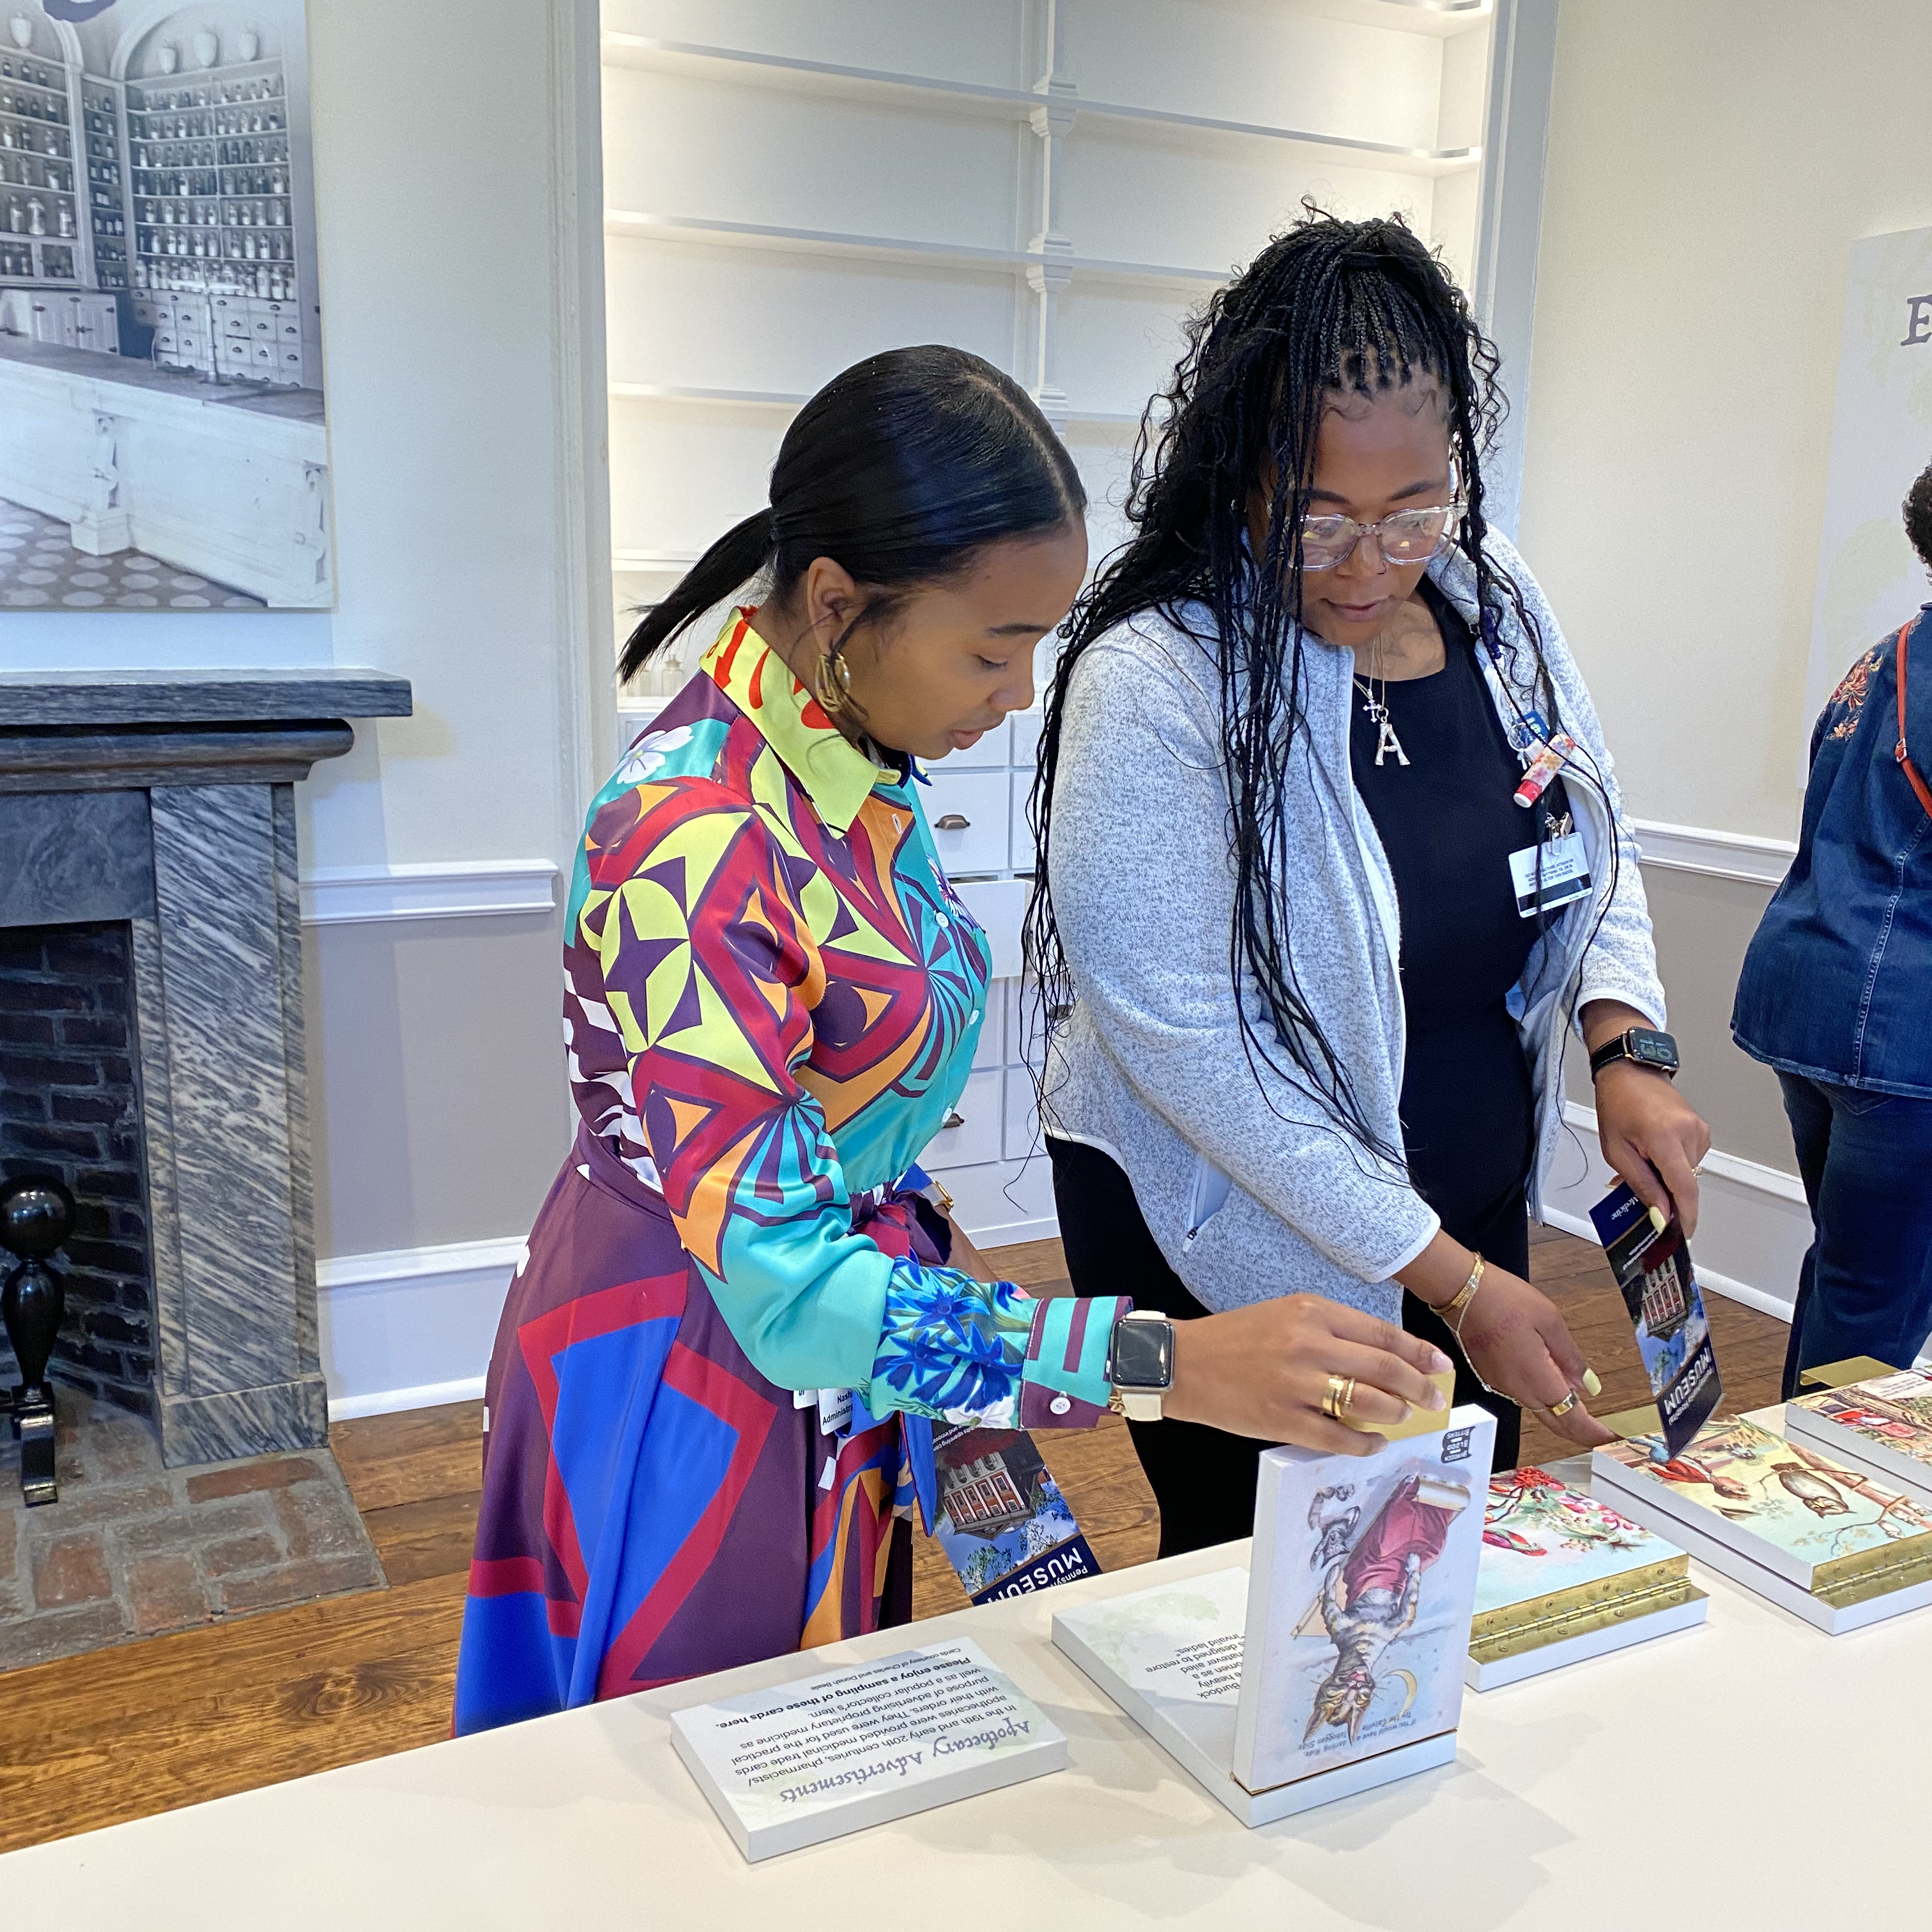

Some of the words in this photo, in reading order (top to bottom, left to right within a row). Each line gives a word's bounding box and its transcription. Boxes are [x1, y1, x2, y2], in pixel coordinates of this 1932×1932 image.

[1663, 1346, 1712, 1415] MUSEUM
[822, 1404, 853, 1425] Administr
[1193, 1644, 1238, 1660] designed
[932, 1657, 972, 1671] Please
[1146, 1660, 1181, 1673] restore
[1181, 1664, 1206, 1674] ailed
[1215, 1662, 1242, 1673] omen
[900, 1667, 931, 1680] enjoy
[958, 1668, 981, 1679] well
[834, 1679, 890, 1697] sampling
[894, 1679, 935, 1696] popular
[946, 1676, 990, 1692] purpose
[1198, 1675, 1236, 1688] heavily
[933, 1689, 945, 1698] of
[974, 1686, 999, 1697] with
[1197, 1682, 1240, 1699] Burdock
[785, 1698, 821, 1710] these
[821, 1694, 834, 1703] of
[871, 1692, 932, 1713] advertising
[949, 1692, 975, 1704] their
[808, 1707, 837, 1718] item.
[909, 1700, 947, 1713] orders.
[938, 1695, 1008, 1718] apothecaries
[985, 1708, 1005, 1717] the
[749, 1707, 784, 1720] cards
[811, 1708, 871, 1730] proprietary
[881, 1711, 911, 1722] They
[960, 1713, 985, 1724] 19th
[715, 1717, 750, 1728] here.
[851, 1719, 880, 1730] were
[909, 1715, 939, 1726] were
[937, 1720, 960, 1733] and
[756, 1726, 809, 1745] medicine
[821, 1727, 850, 1740] used
[859, 1721, 908, 1743] provided
[910, 1727, 937, 1740] early
[932, 1716, 1030, 1758] Apothecary
[1362, 1730, 1377, 1740] have
[739, 1741, 755, 1749] as
[783, 1740, 804, 1749] the
[804, 1735, 822, 1744] for
[881, 1735, 908, 1747] 20th
[802, 1736, 858, 1758] medicinal
[824, 1743, 880, 1762] centuries,
[731, 1744, 781, 1766] practical
[770, 1753, 802, 1766] trade
[735, 1762, 768, 1775] cards
[748, 1757, 824, 1787] pharmacists/
[779, 1751, 923, 1803] Advertisements
